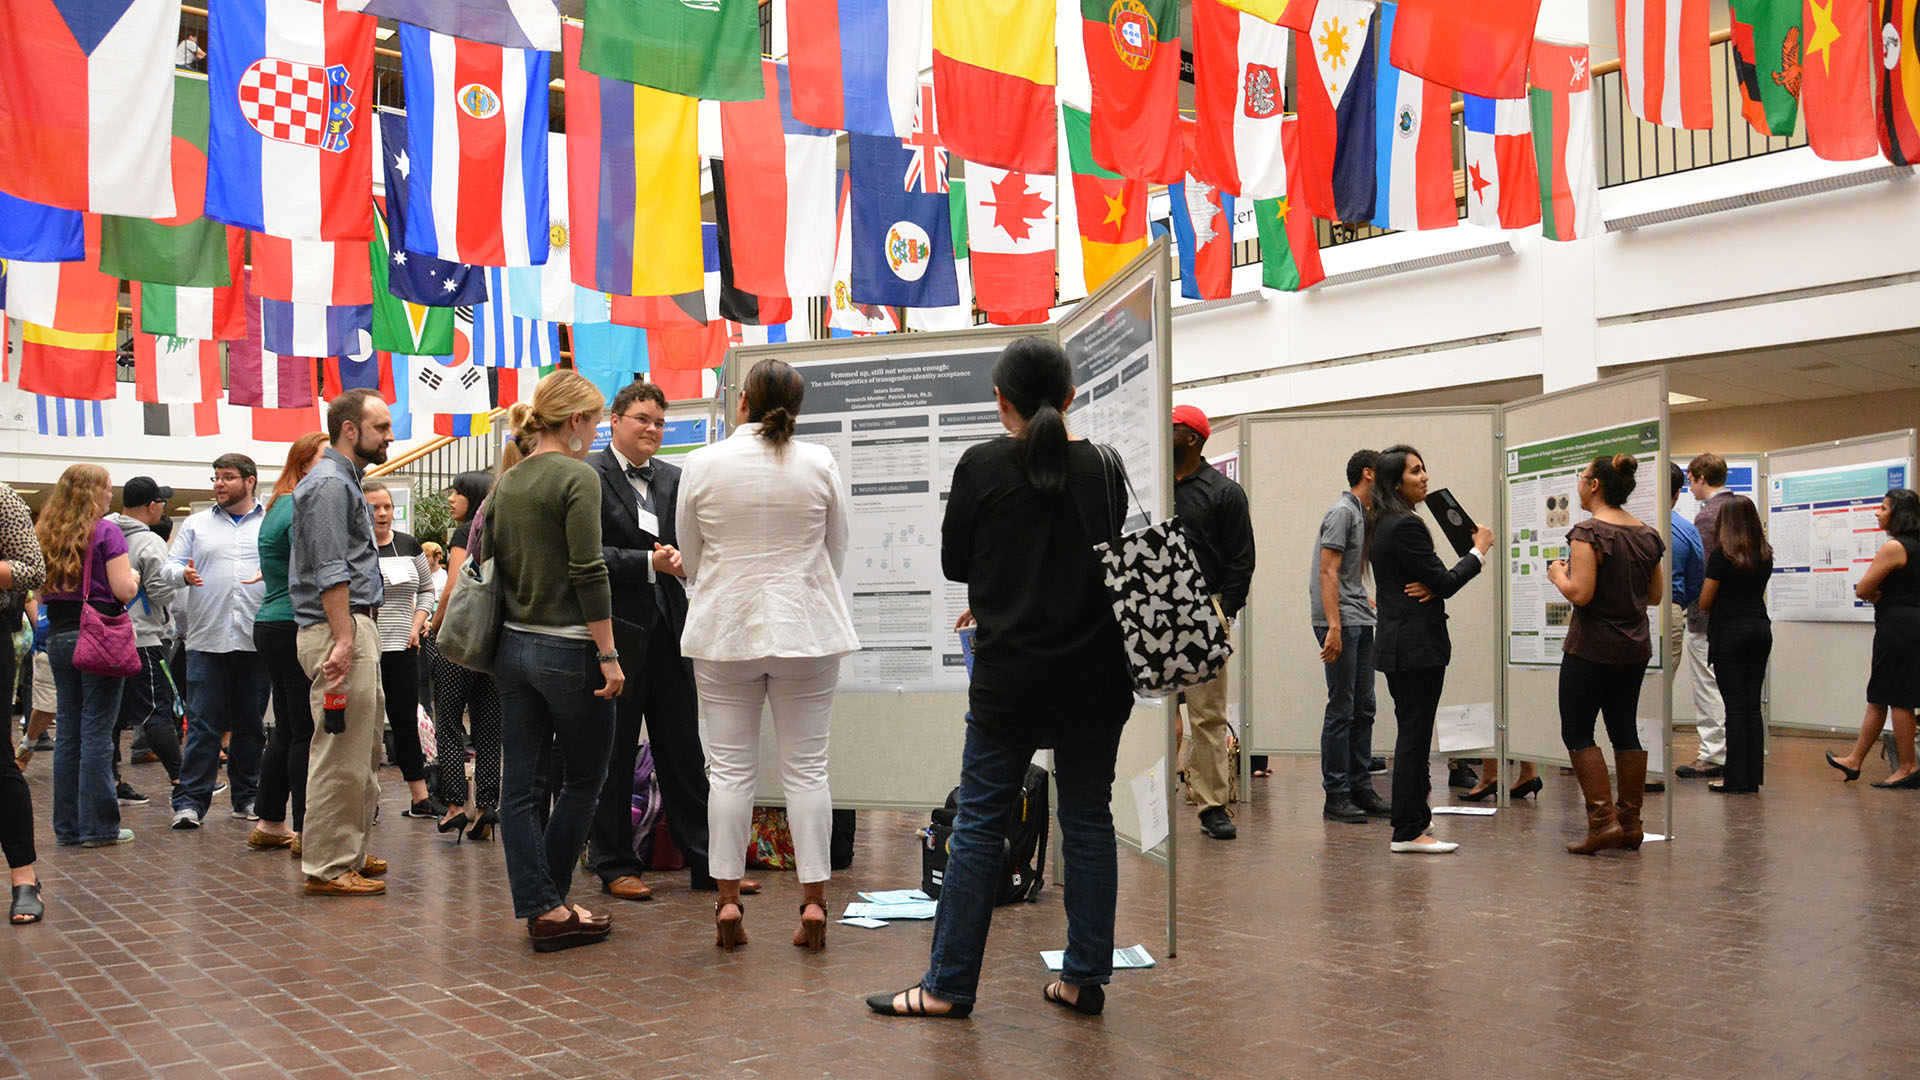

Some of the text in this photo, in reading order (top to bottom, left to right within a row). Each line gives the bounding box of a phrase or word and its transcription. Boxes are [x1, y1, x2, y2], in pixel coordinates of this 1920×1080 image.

[823, 377, 868, 387] sociolinguistics
[876, 374, 912, 383] transgender
[913, 371, 936, 381] identity
[937, 370, 971, 380] acceptance
[831, 370, 858, 379] Femmed
[871, 368, 884, 376] still
[923, 364, 950, 373] enough:
[851, 402, 875, 410] University
